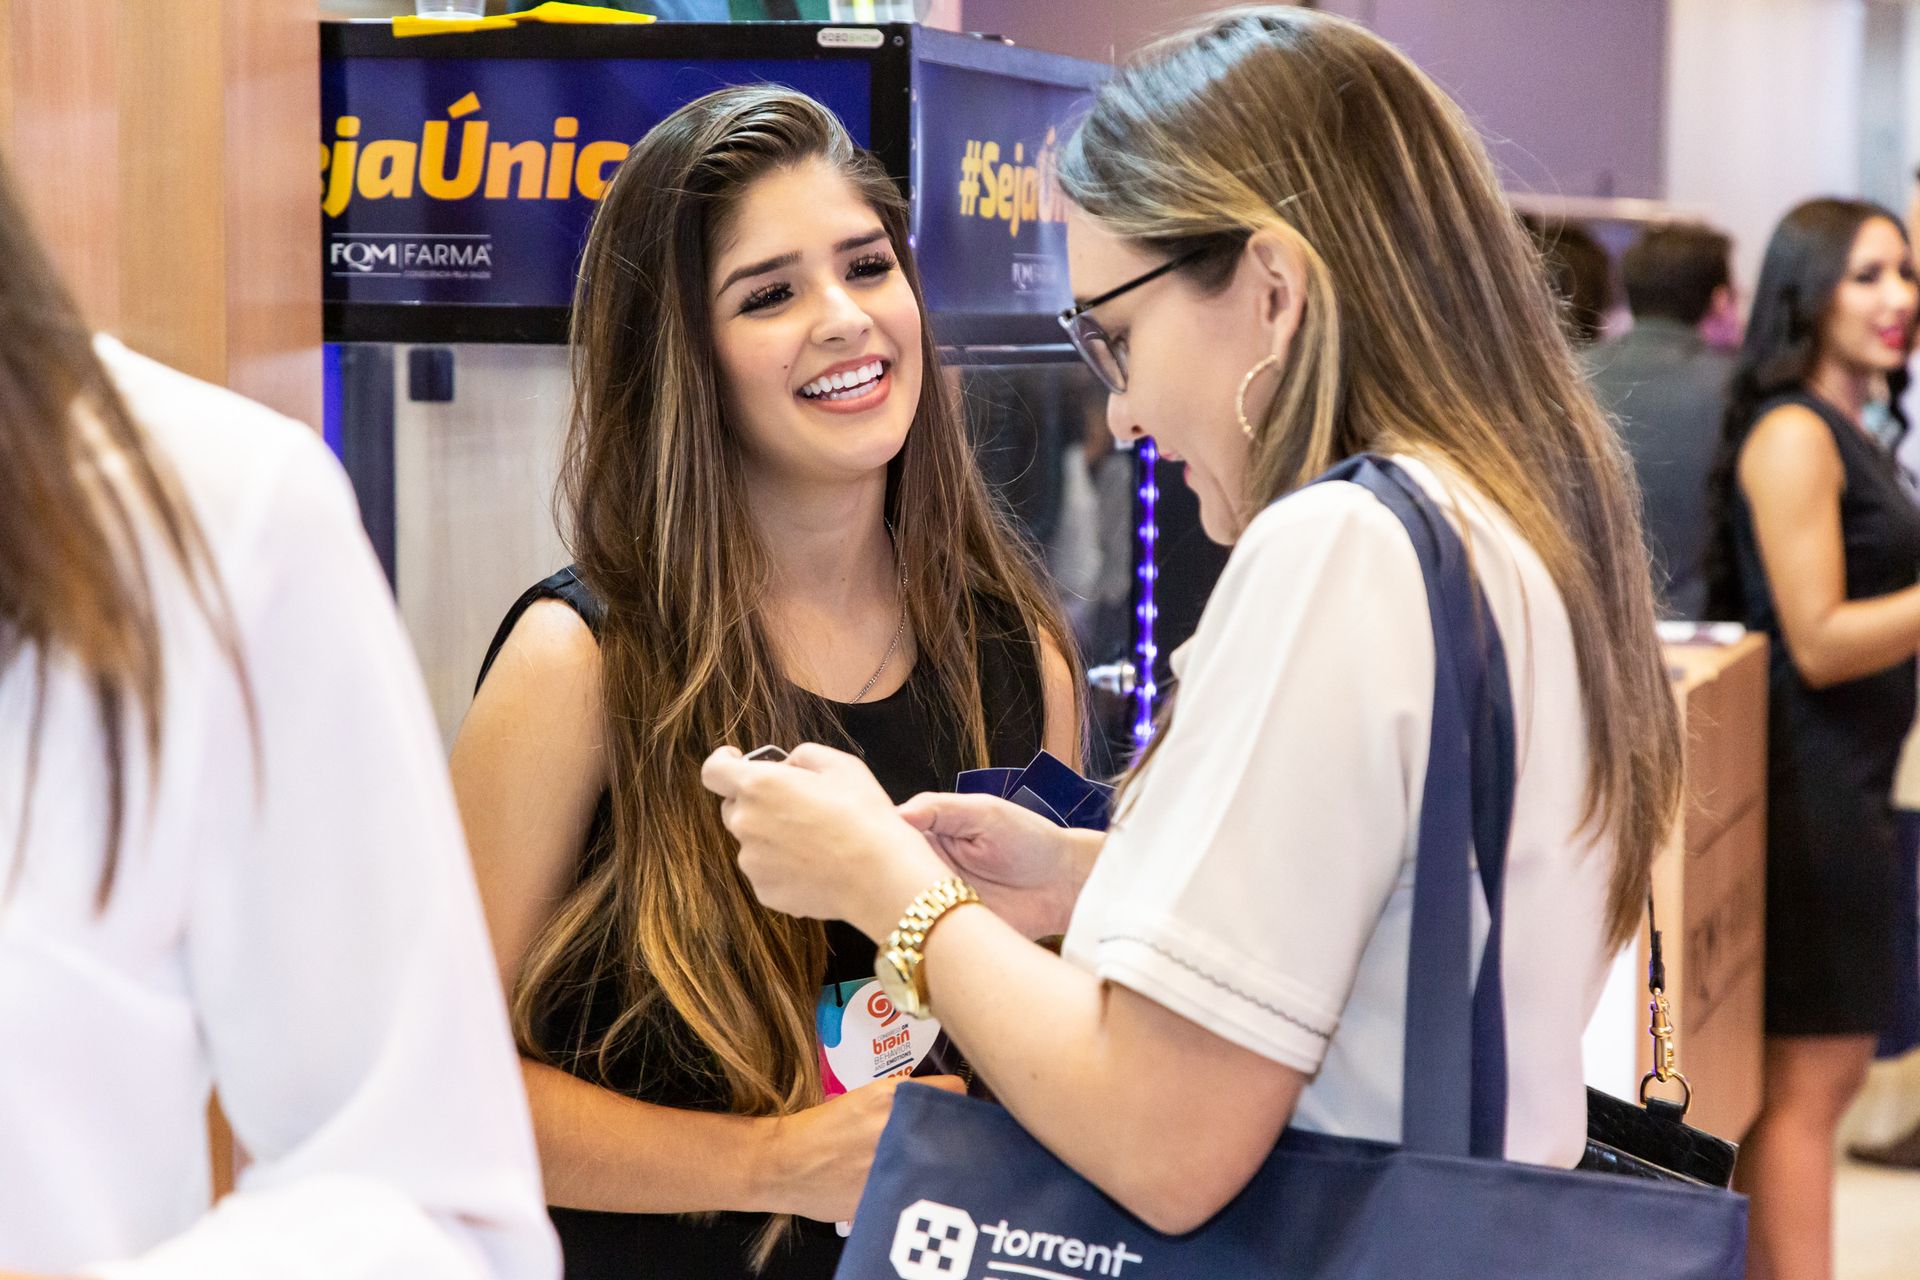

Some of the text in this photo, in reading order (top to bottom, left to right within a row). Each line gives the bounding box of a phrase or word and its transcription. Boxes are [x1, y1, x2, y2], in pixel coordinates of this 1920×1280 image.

[330, 242, 397, 272] FQM
[873, 1029, 910, 1055] brain
[875, 1042, 911, 1065] BEHAVIOR
[886, 1051, 911, 1066] EMOTIONS
[980, 1219, 1143, 1277] torrent
